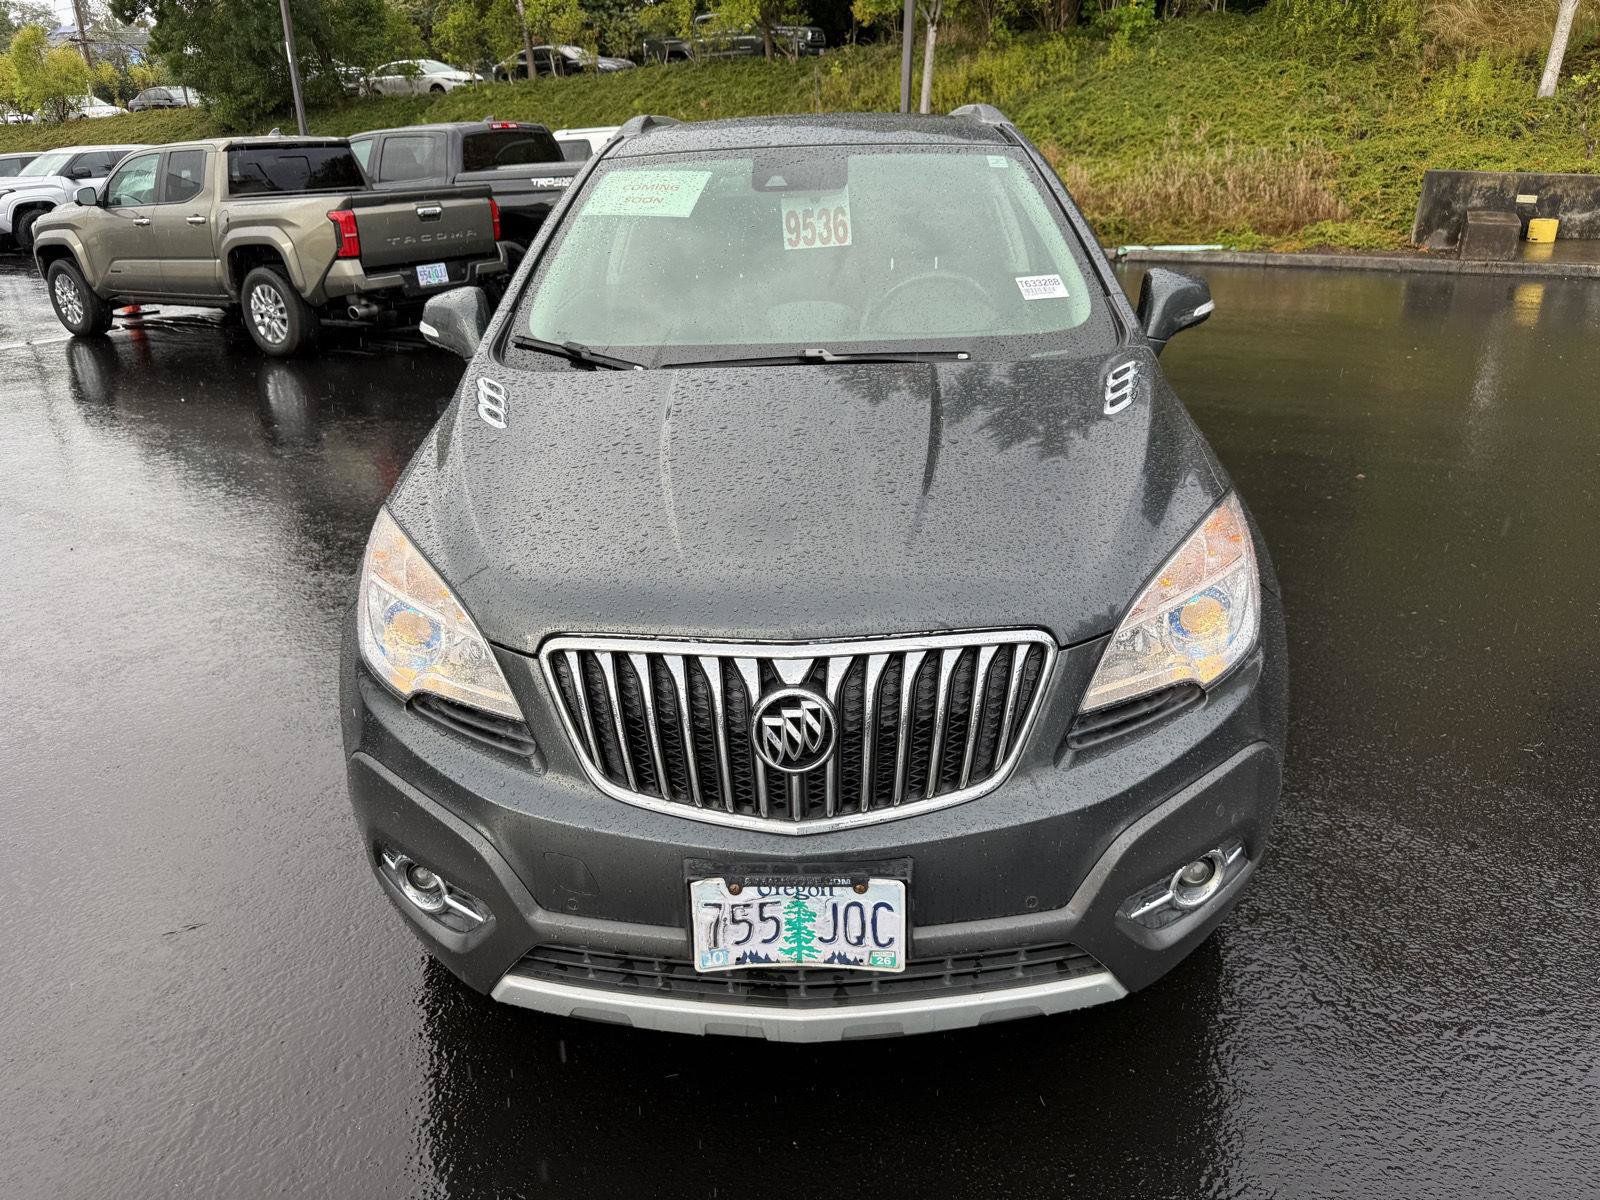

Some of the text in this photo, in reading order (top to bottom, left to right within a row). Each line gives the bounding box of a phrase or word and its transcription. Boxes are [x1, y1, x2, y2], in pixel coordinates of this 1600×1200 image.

[622, 183, 681, 192] COMING
[624, 196, 665, 204] SOON
[785, 206, 849, 248] 9536
[386, 230, 478, 245] TACOMA
[757, 885, 836, 900] Oregon
[702, 901, 895, 949] 755 JQC
[876, 956, 892, 965] 26
